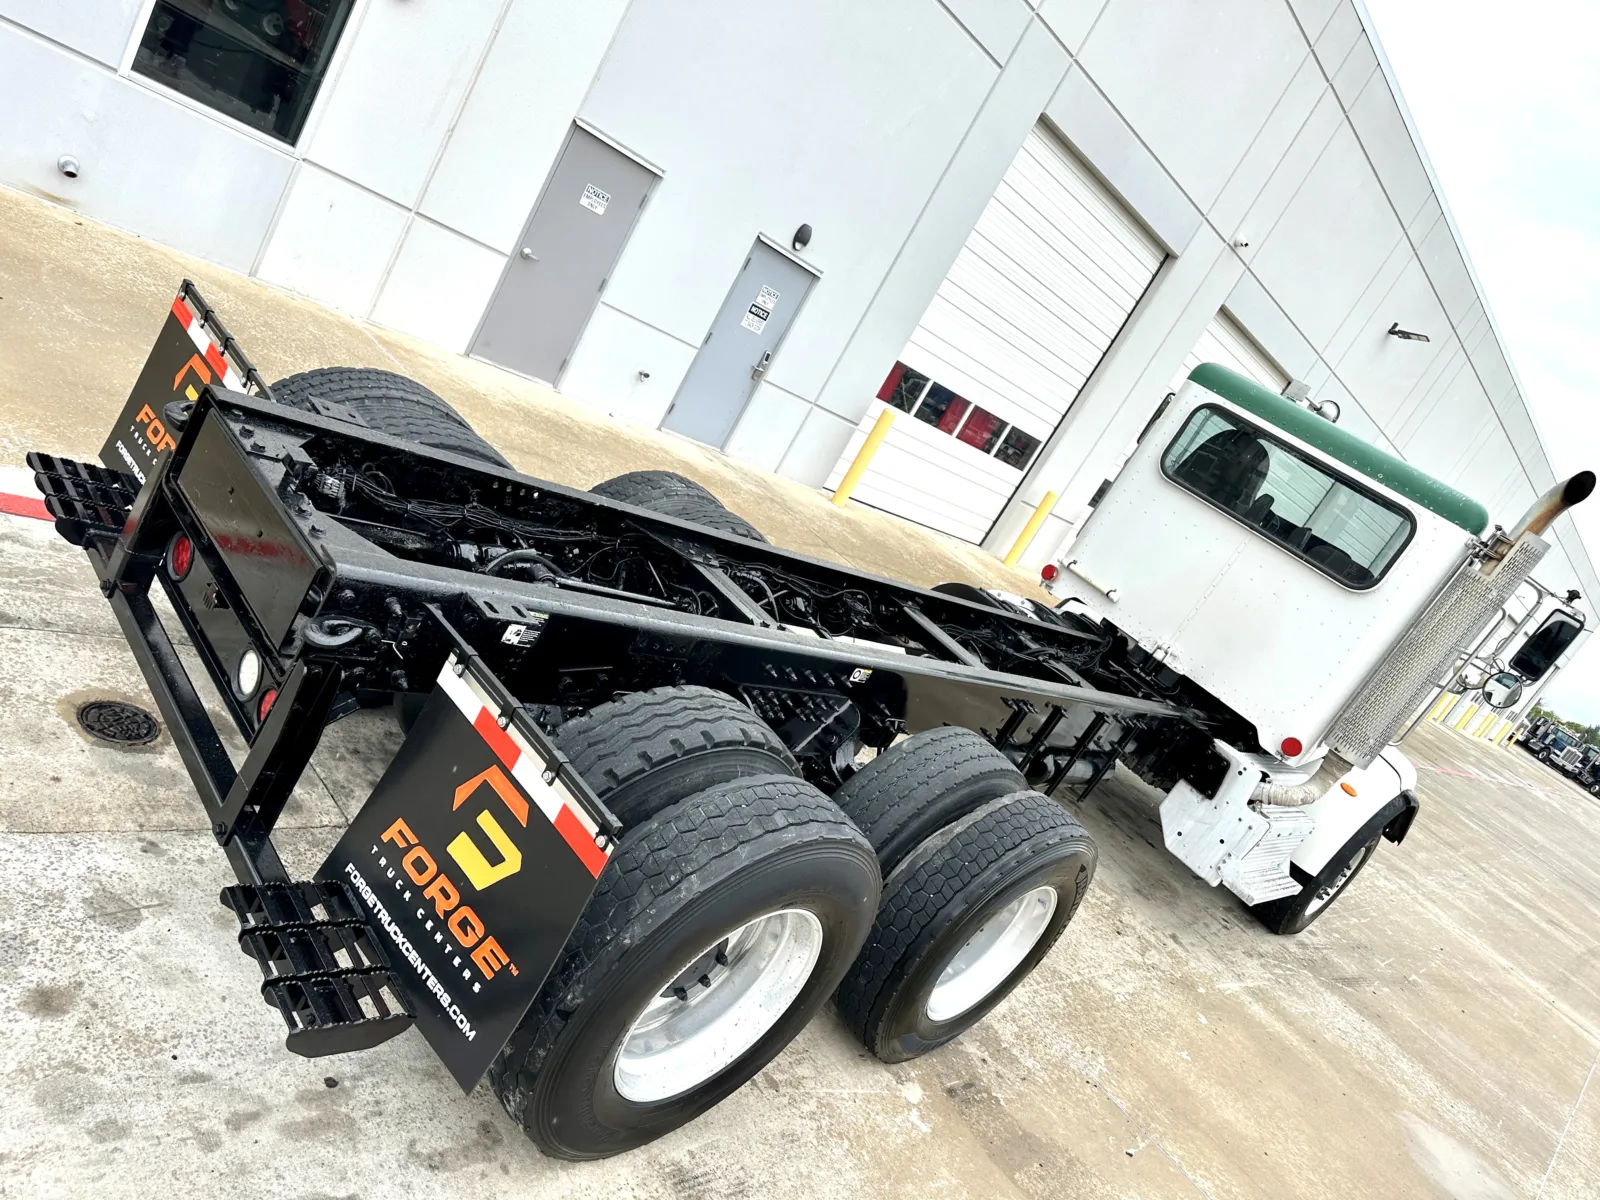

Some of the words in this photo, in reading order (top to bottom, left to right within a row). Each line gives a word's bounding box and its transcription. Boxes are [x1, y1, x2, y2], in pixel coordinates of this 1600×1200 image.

[586, 186, 609, 204] NOTICE
[751, 305, 769, 320] NOTICE
[130, 425, 152, 457] TRUCK
[135, 404, 177, 452] FOR
[370, 845, 411, 902] TRUCK
[416, 908, 481, 993] CENTERS
[380, 817, 510, 980] FORGE
[344, 862, 477, 1042] FORGETRUCKCENTERS.COM
